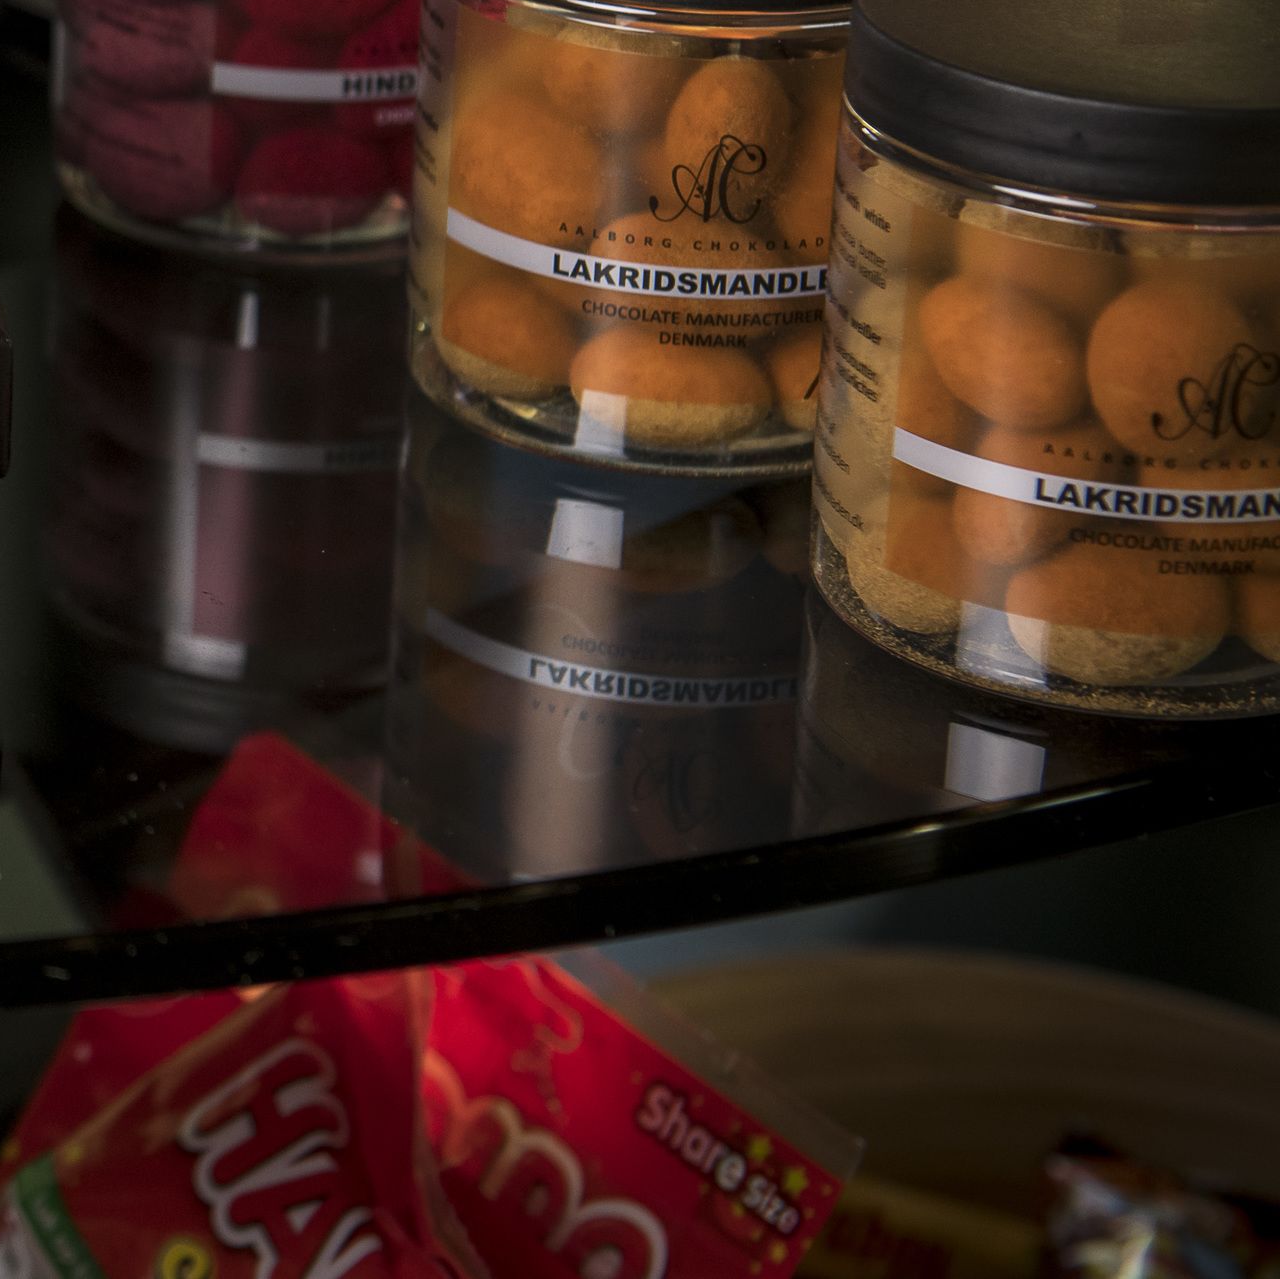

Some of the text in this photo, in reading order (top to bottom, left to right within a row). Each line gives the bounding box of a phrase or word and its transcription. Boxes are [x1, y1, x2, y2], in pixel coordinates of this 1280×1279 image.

[558, 222, 673, 250] AALBORG
[582, 299, 825, 328] CHOCOLATE MANUFACTURER
[658, 331, 748, 349] DENMARK
[1069, 527, 1184, 552] CHOCOLATE
[637, 1083, 748, 1192] Share
